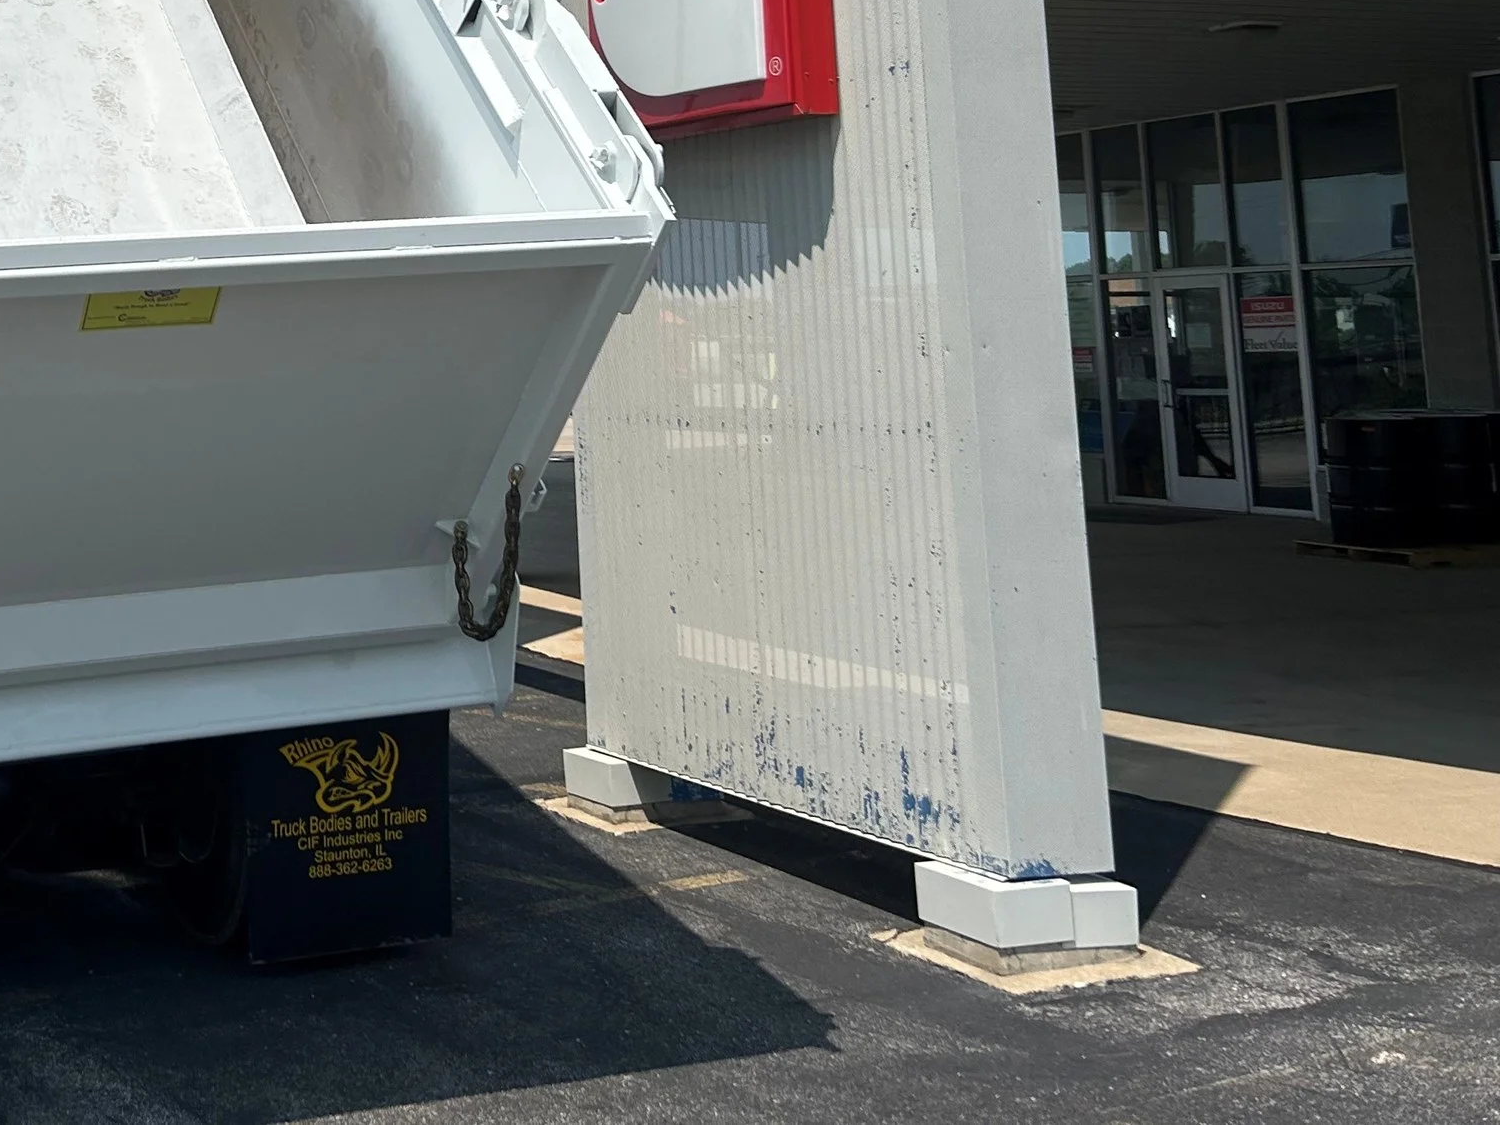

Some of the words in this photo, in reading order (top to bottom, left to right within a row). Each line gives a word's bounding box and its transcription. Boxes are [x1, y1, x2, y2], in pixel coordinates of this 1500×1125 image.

[1250, 302, 1285, 311] ISUZU
[1244, 339, 1268, 350] Fleet
[279, 736, 335, 764] Rhino
[271, 818, 306, 838] Truck
[310, 813, 352, 834] Bodies
[356, 811, 379, 829] and
[382, 806, 427, 826] Trailers
[298, 836, 320, 850] CIF
[323, 830, 381, 847] Industries
[385, 828, 403, 841] Inc
[314, 847, 372, 864] Staunton,
[375, 844, 387, 856] IL
[308, 857, 393, 879] 888-362-6263
